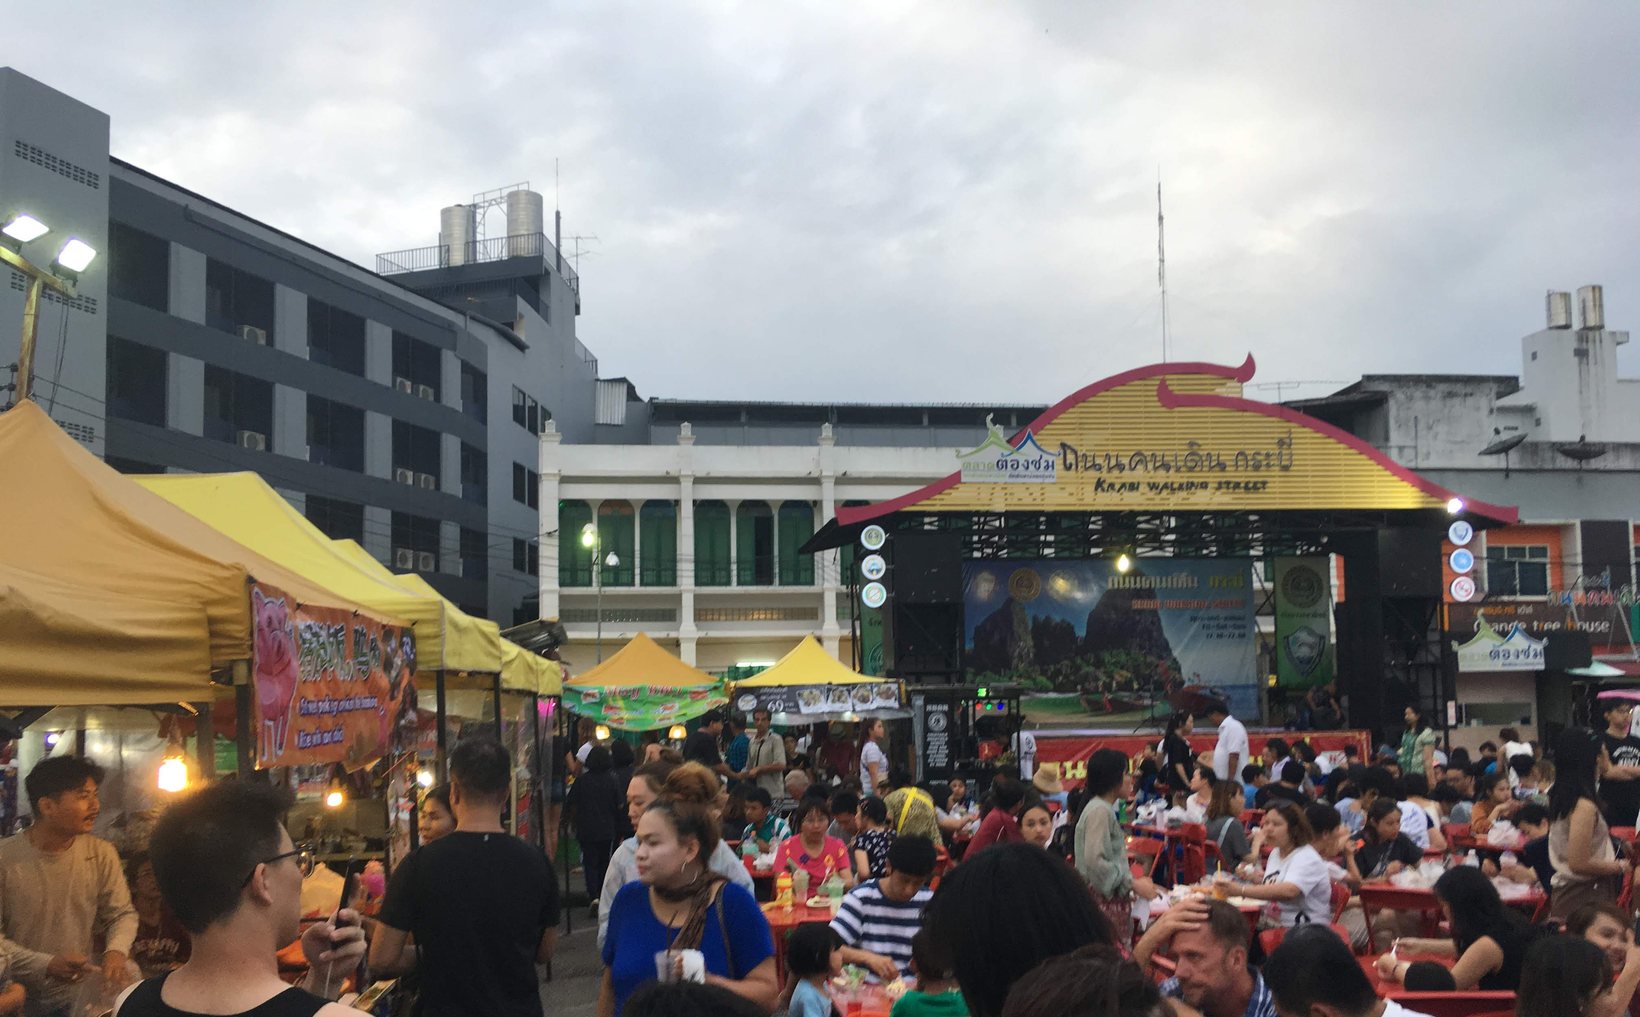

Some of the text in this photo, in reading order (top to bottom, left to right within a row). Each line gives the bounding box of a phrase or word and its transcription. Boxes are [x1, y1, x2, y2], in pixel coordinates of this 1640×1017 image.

[1094, 477, 1268, 493] KRABI WALKING STREET
[1533, 620, 1561, 632] tree
